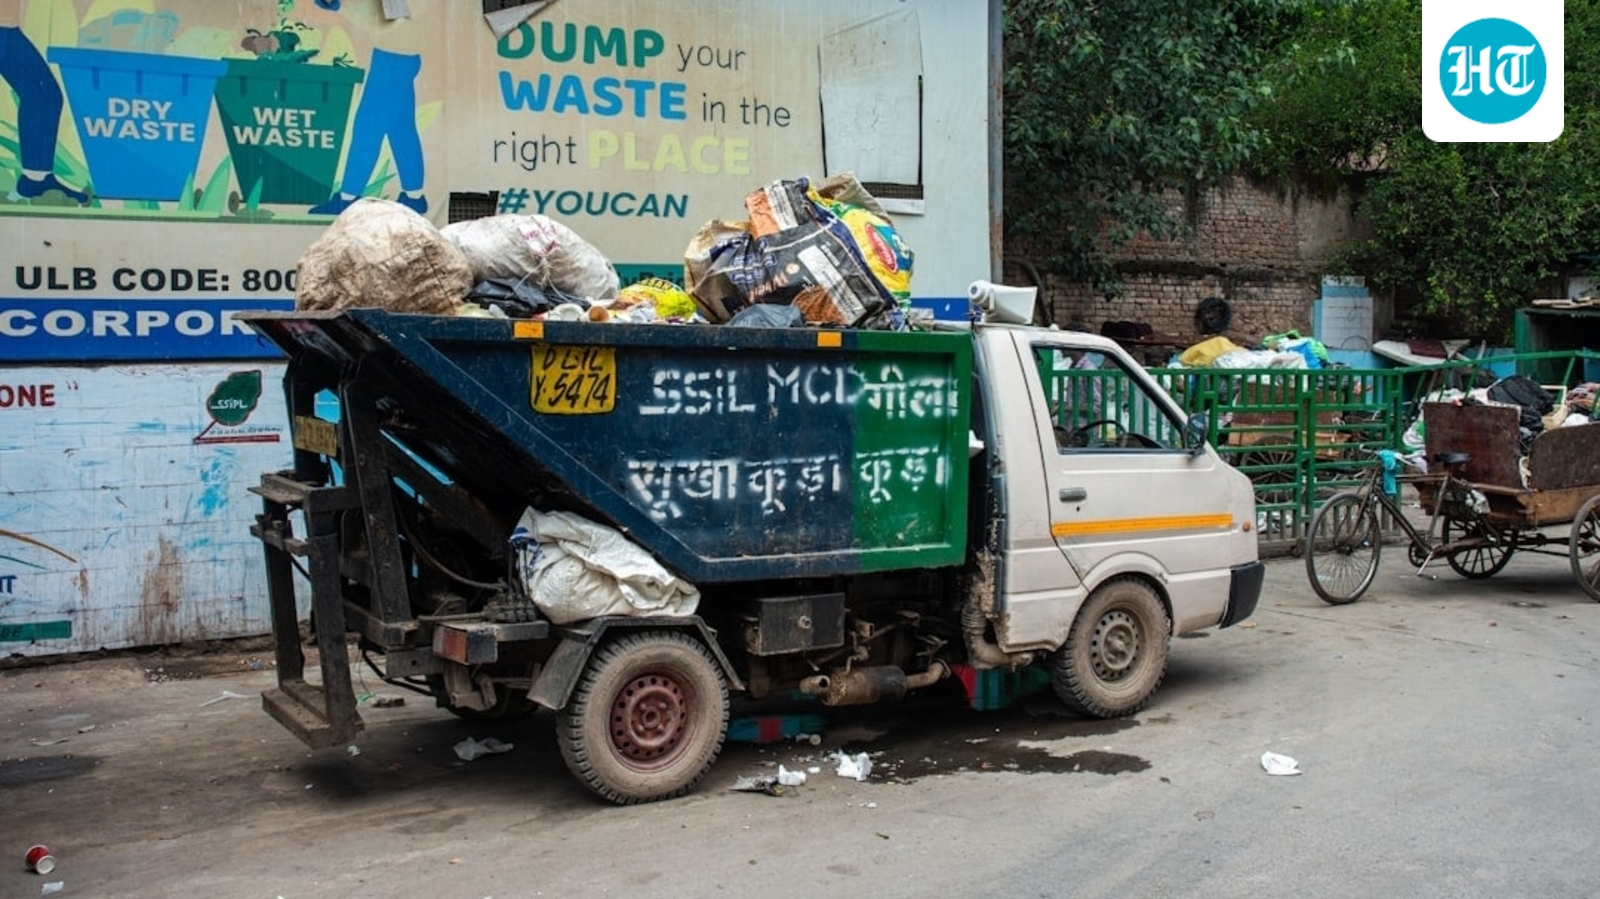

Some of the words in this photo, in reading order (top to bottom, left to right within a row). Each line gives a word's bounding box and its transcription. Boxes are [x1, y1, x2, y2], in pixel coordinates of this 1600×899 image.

[498, 20, 665, 69] DUMP
[676, 41, 747, 72] your
[107, 97, 173, 121] DRY
[498, 71, 688, 121] WASTE
[702, 93, 727, 125] in
[739, 96, 792, 128] the
[83, 117, 195, 142] WASTE
[252, 106, 316, 129] WET
[232, 125, 335, 149] WASTE
[492, 131, 577, 172] right
[587, 130, 752, 176] PLACE
[498, 187, 689, 219] #YOUCAN
[15, 266, 97, 291] ULB
[112, 267, 230, 292] CODE:
[0, 384, 56, 408] ONE
[767, 363, 866, 405] MCD
[864, 363, 958, 420] गीला
